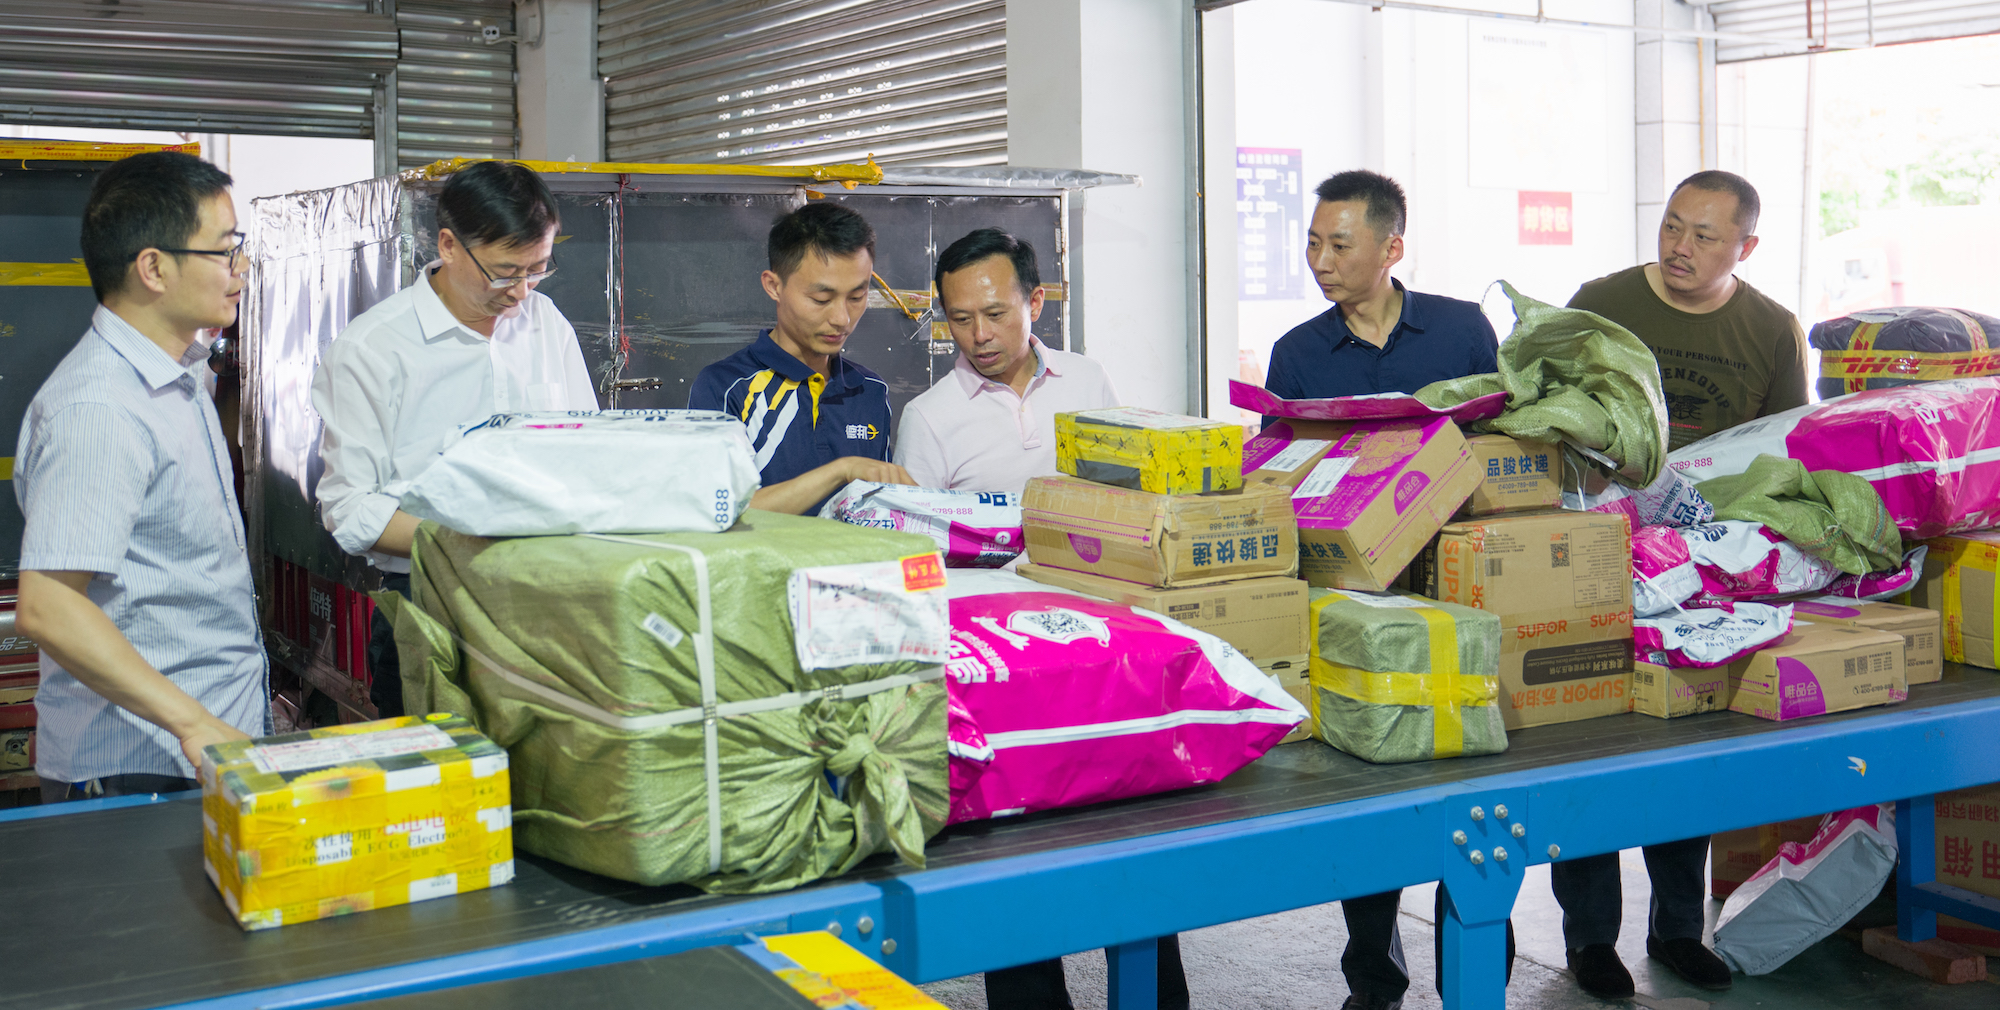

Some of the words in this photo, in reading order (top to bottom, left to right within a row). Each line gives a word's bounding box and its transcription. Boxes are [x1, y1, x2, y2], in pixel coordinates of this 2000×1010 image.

[1523, 205, 1569, 233] 卸货区
[1656, 346, 1682, 358] YOUR
[1685, 350, 1748, 371] PERSONALITY
[1842, 357, 1922, 375] DHL
[846, 424, 868, 440] 德邦
[1487, 454, 1549, 477] 品骏快递
[1396, 475, 1420, 502] 唯品会
[1192, 534, 1278, 567] 品骏快递
[309, 586, 332, 622] 倍特
[1516, 620, 1567, 639] SUPOR
[1512, 687, 1557, 710] 苏泊尔
[1563, 680, 1624, 703] SUPOR
[1674, 680, 1724, 701] vip.com
[1784, 681, 1818, 700] 唯品会
[367, 838, 400, 854] ECG
